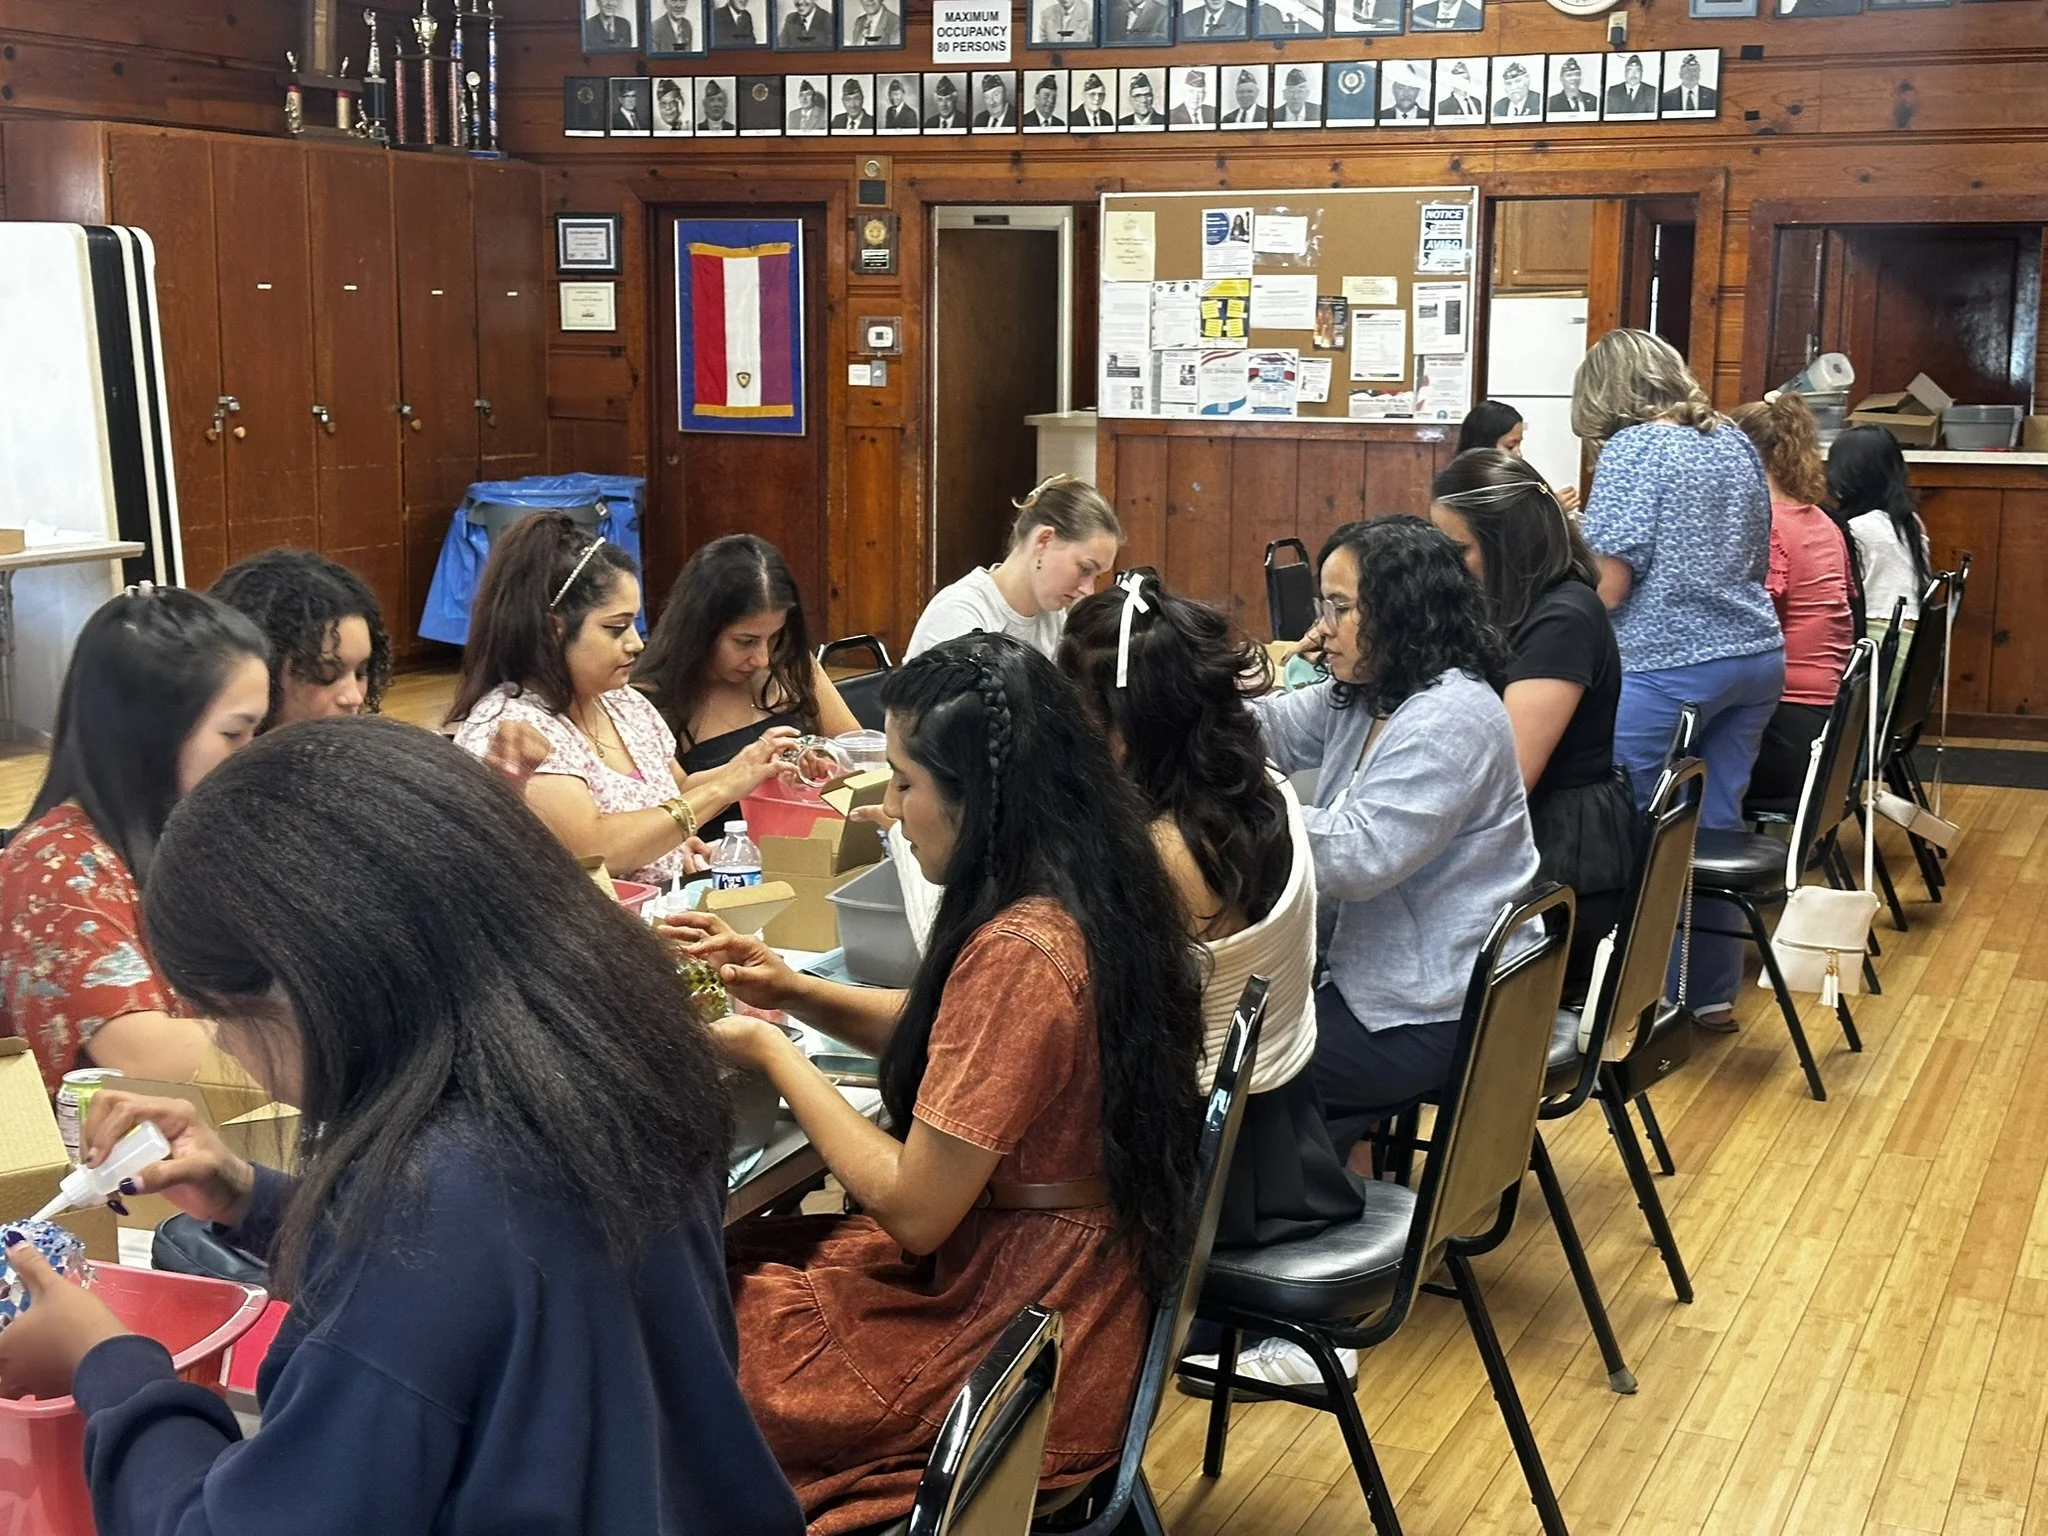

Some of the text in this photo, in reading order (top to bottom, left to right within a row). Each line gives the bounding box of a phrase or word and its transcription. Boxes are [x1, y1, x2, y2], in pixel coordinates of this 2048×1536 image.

[945, 11, 999, 22] MAXIMUM
[937, 26, 1007, 37] OCCUPANCY
[937, 41, 1006, 52] 80 PERSONS
[1426, 210, 1463, 219] NOTICE
[1425, 240, 1460, 249] AVISO
